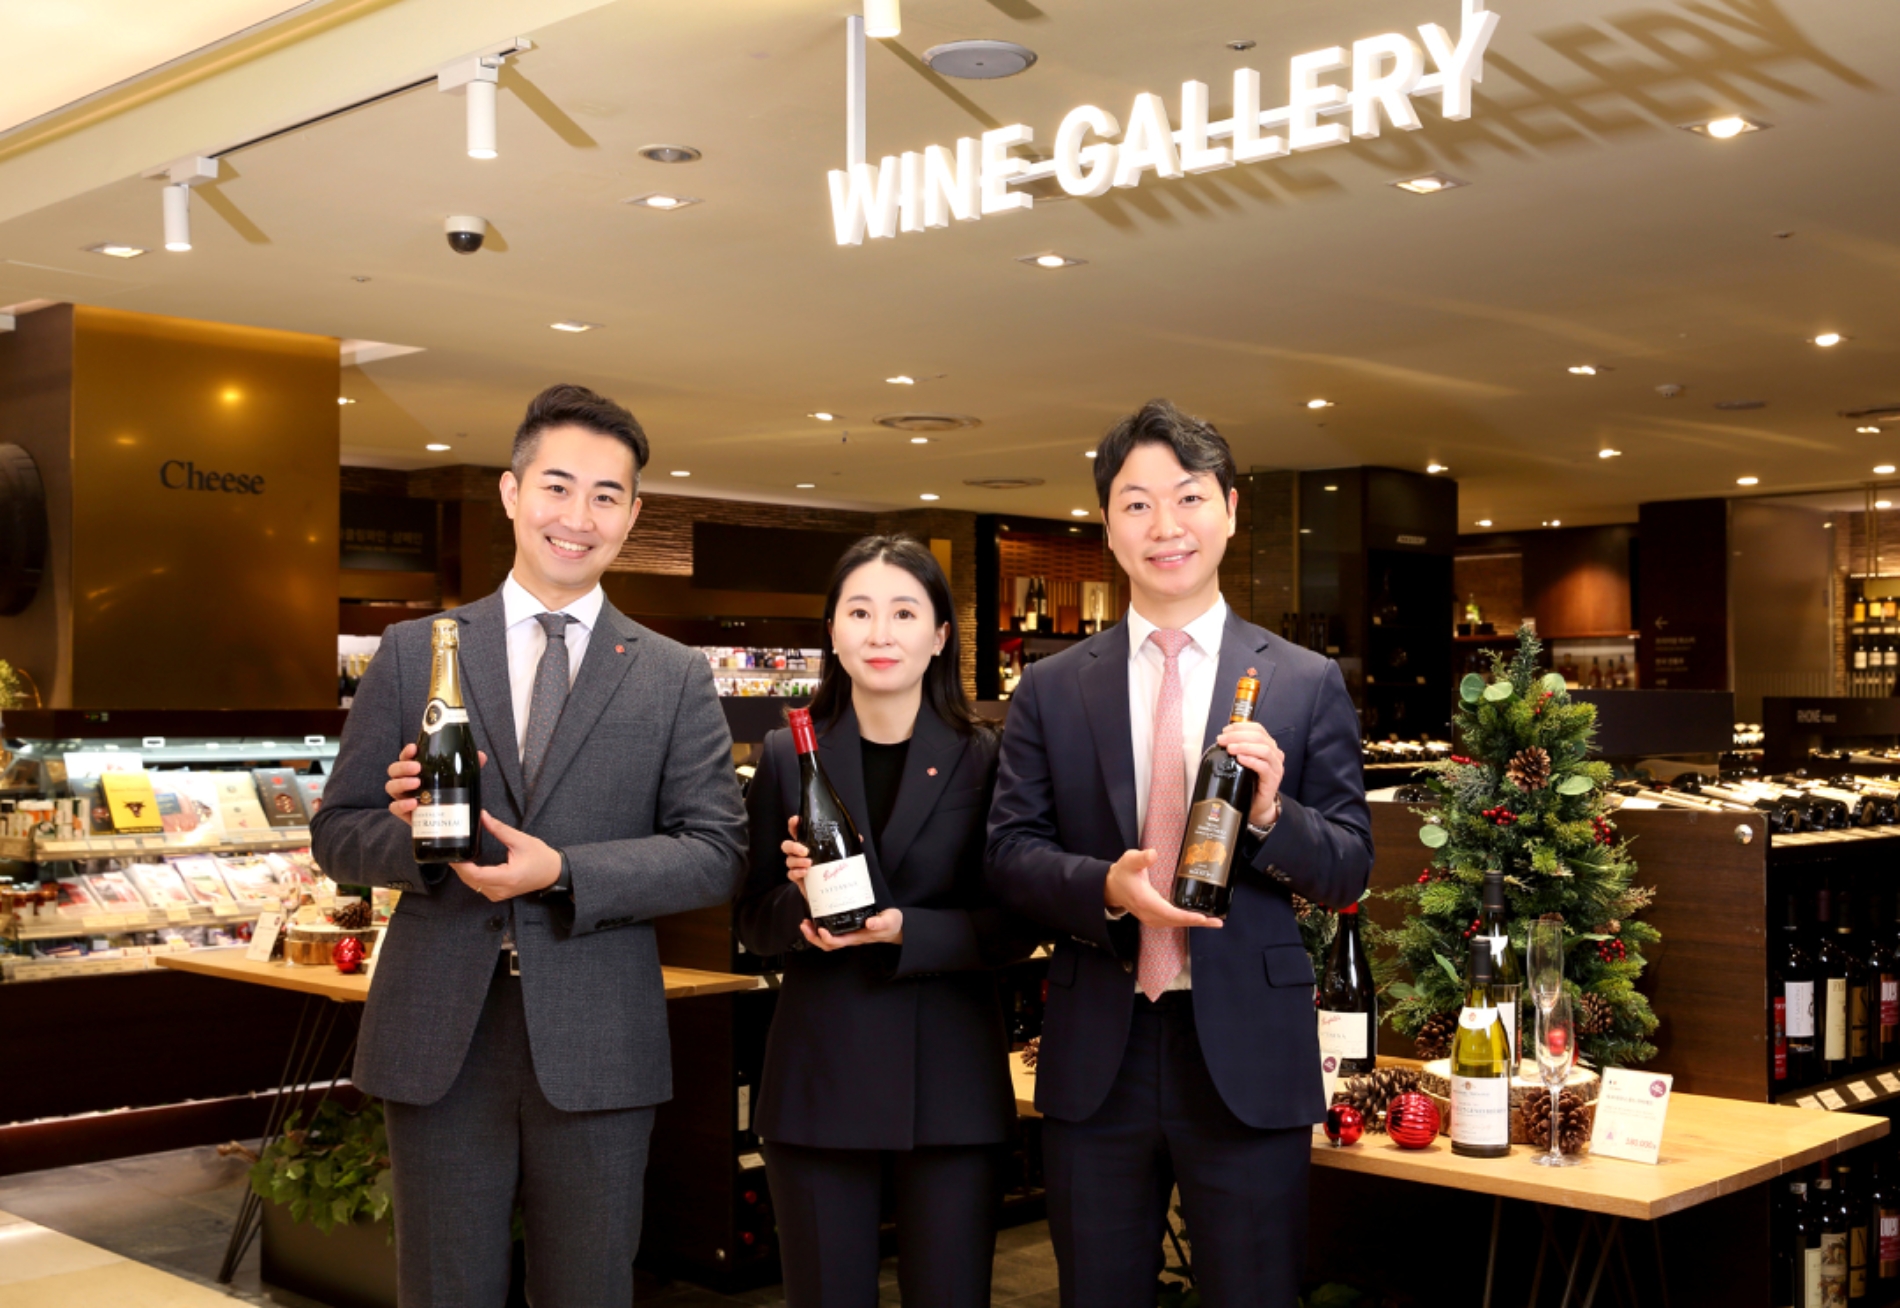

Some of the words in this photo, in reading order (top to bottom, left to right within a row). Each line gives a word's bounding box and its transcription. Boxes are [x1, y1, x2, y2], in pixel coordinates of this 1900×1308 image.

[828, 124, 1033, 245] WINE
[1054, 10, 1500, 198] GALLERY
[159, 459, 265, 495] Cheese
